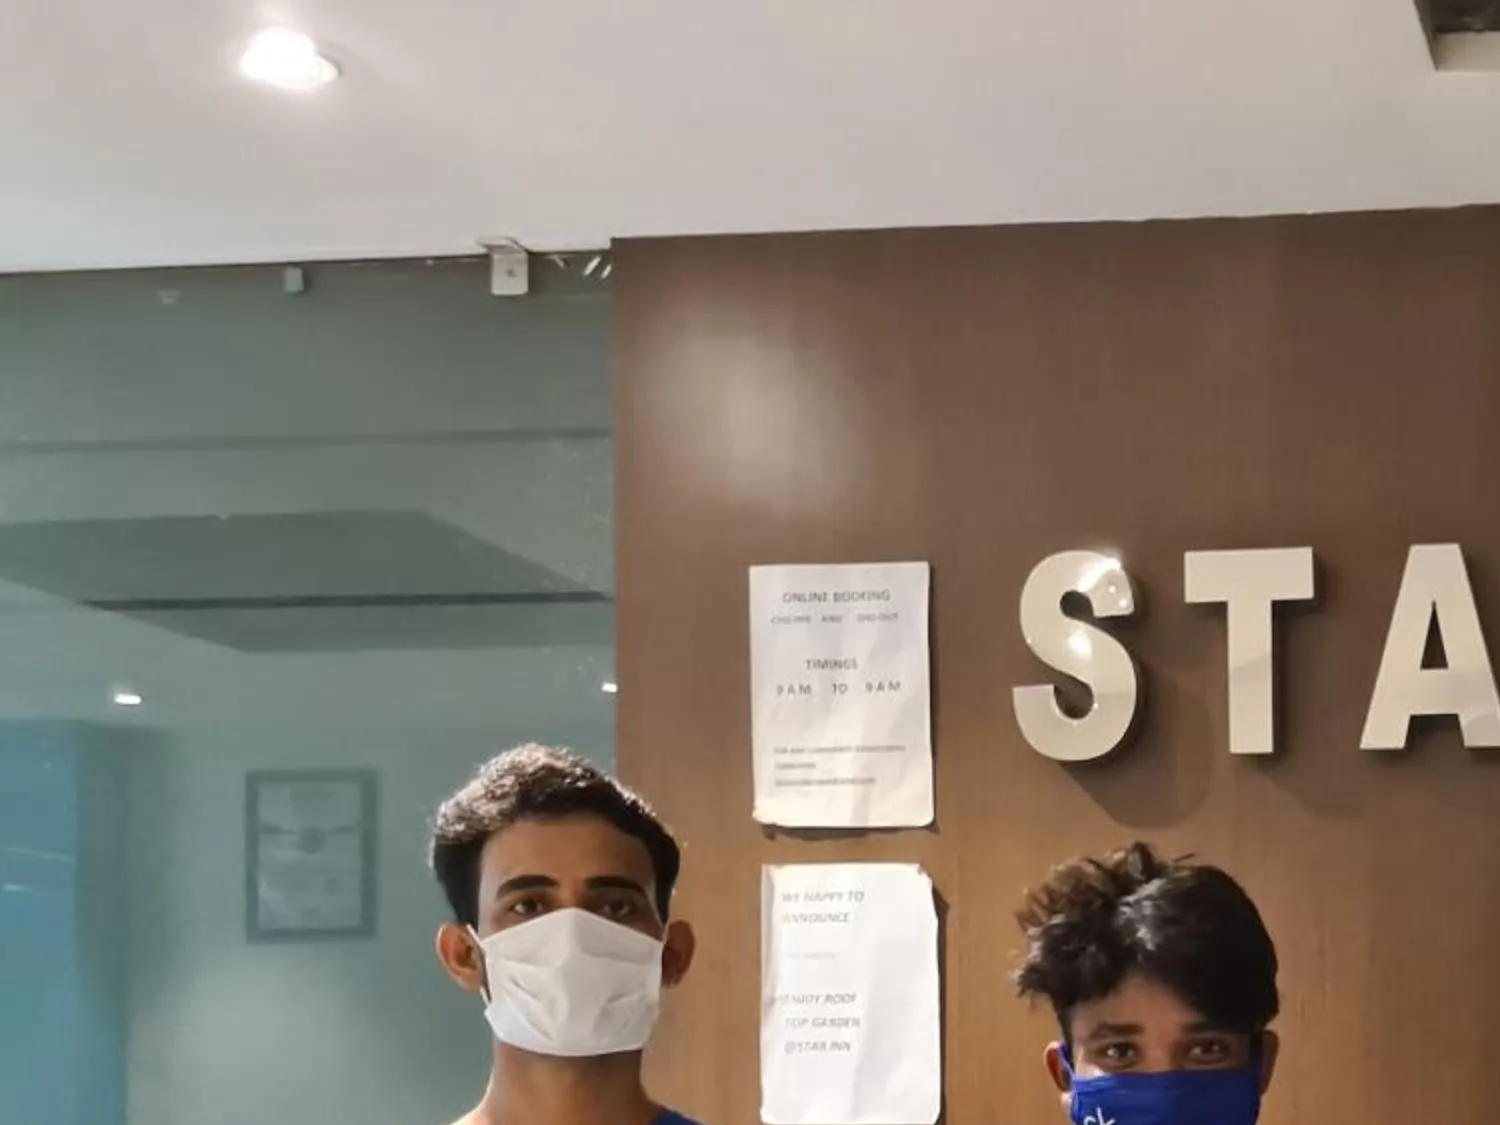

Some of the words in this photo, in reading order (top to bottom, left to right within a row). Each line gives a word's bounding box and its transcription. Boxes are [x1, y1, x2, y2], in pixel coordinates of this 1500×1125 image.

[782, 591, 827, 604] ONLINE
[833, 589, 891, 603] BOOKING
[805, 658, 858, 670] TIMINGS
[848, 890, 865, 902] TO
[782, 912, 850, 924] ANNOUNCE
[824, 993, 857, 1004] ROOF
[811, 1016, 861, 1028] GARDEN
[829, 1041, 852, 1052] INN
